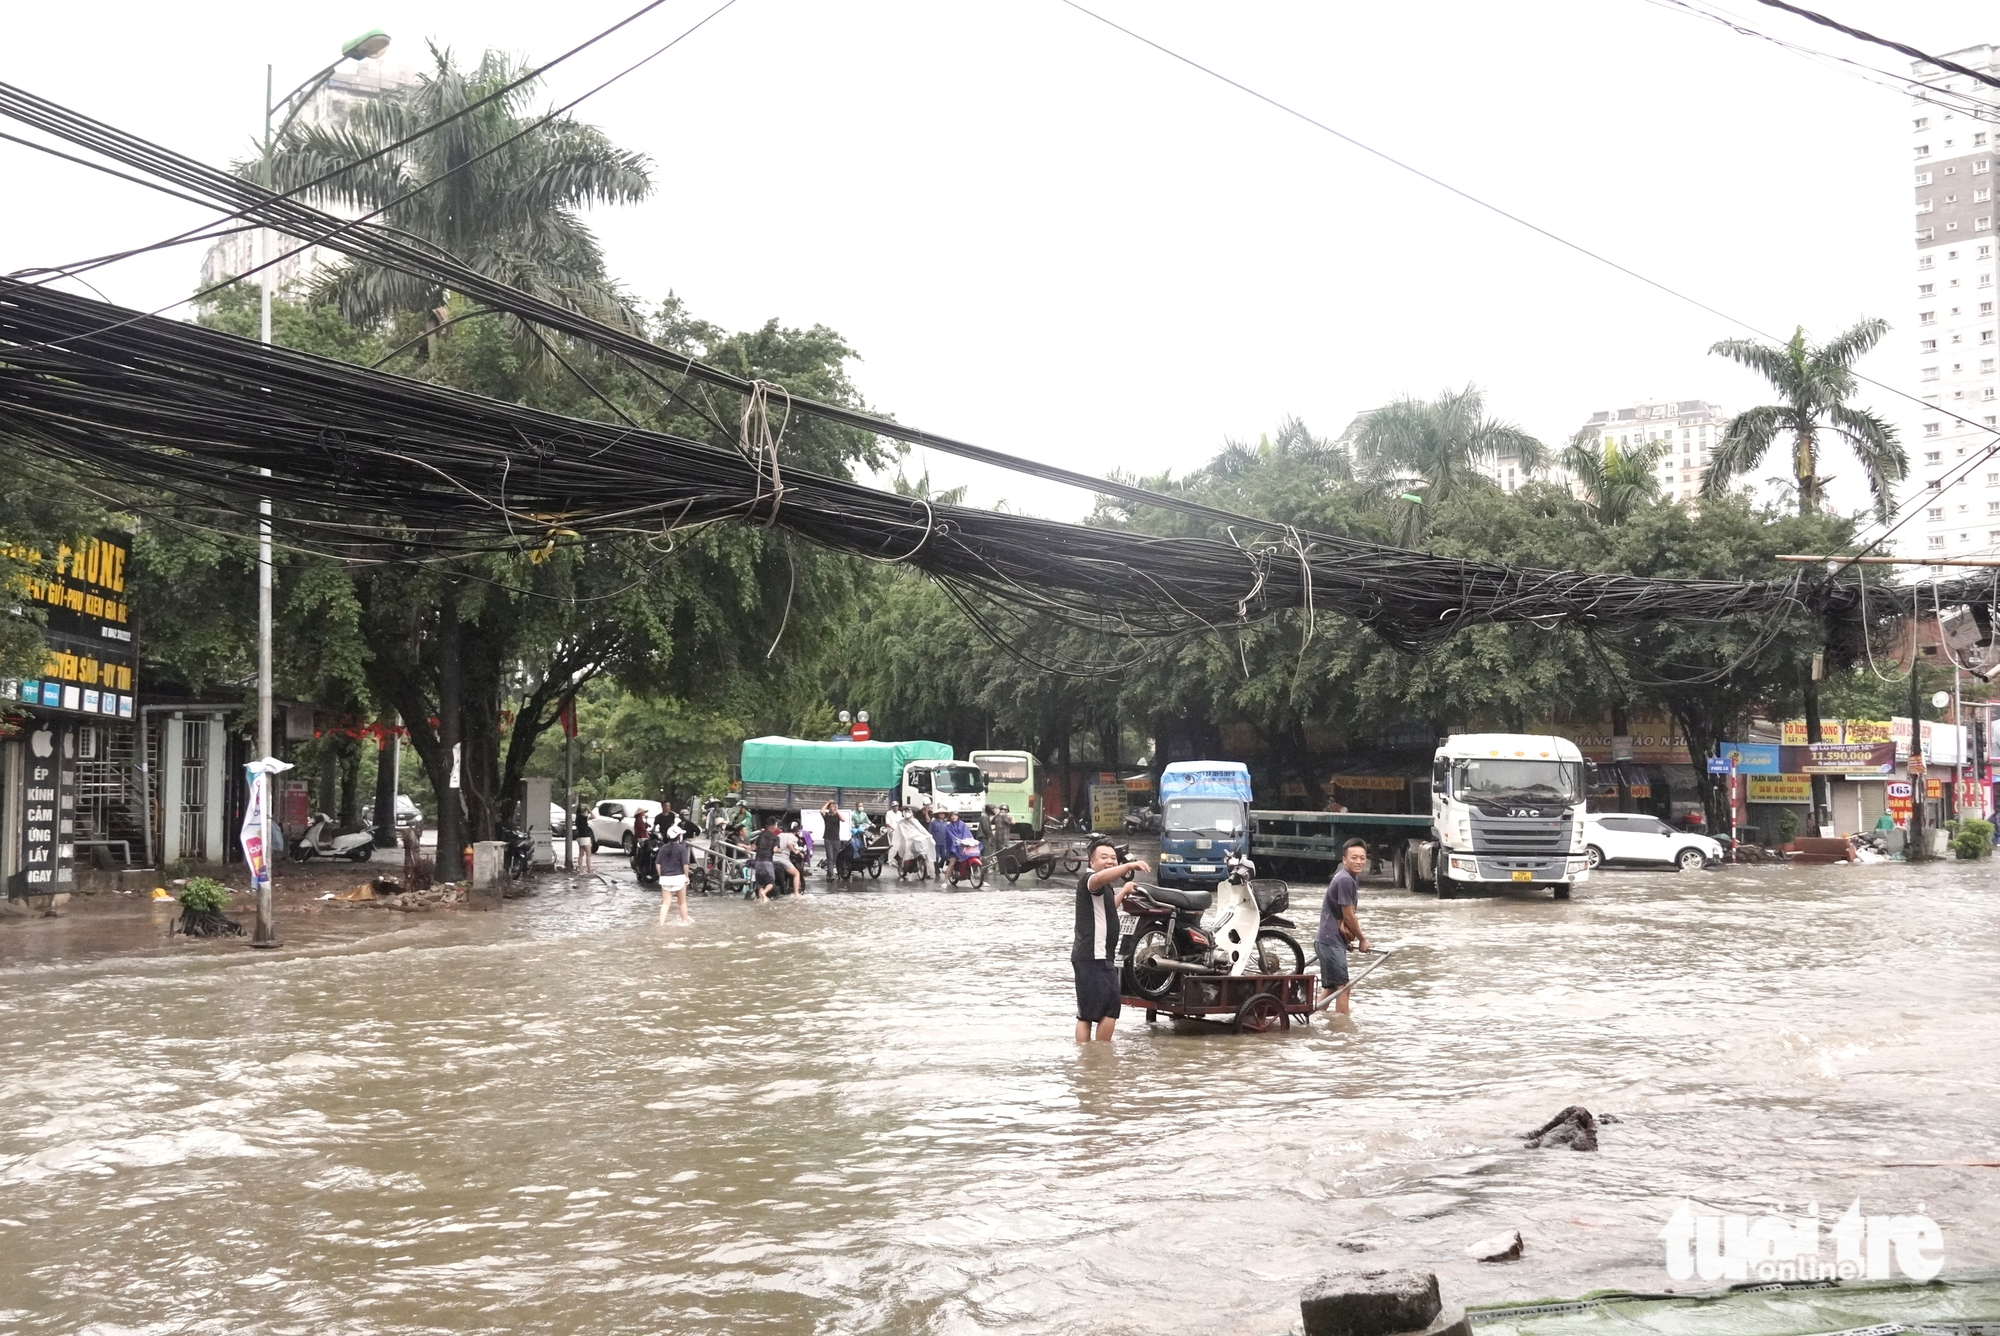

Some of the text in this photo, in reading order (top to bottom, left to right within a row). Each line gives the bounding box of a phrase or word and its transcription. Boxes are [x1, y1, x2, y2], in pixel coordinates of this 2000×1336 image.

[1574, 732, 1612, 747] HÀNG
[1811, 751, 1873, 761] 11.590.000
[34, 766, 49, 781] ÉP
[27, 786, 54, 801] KÍNH
[1890, 785, 1910, 795] 165
[27, 805, 53, 821] CẢM
[1506, 809, 1540, 818] JAC
[28, 845, 49, 862] LẤY
